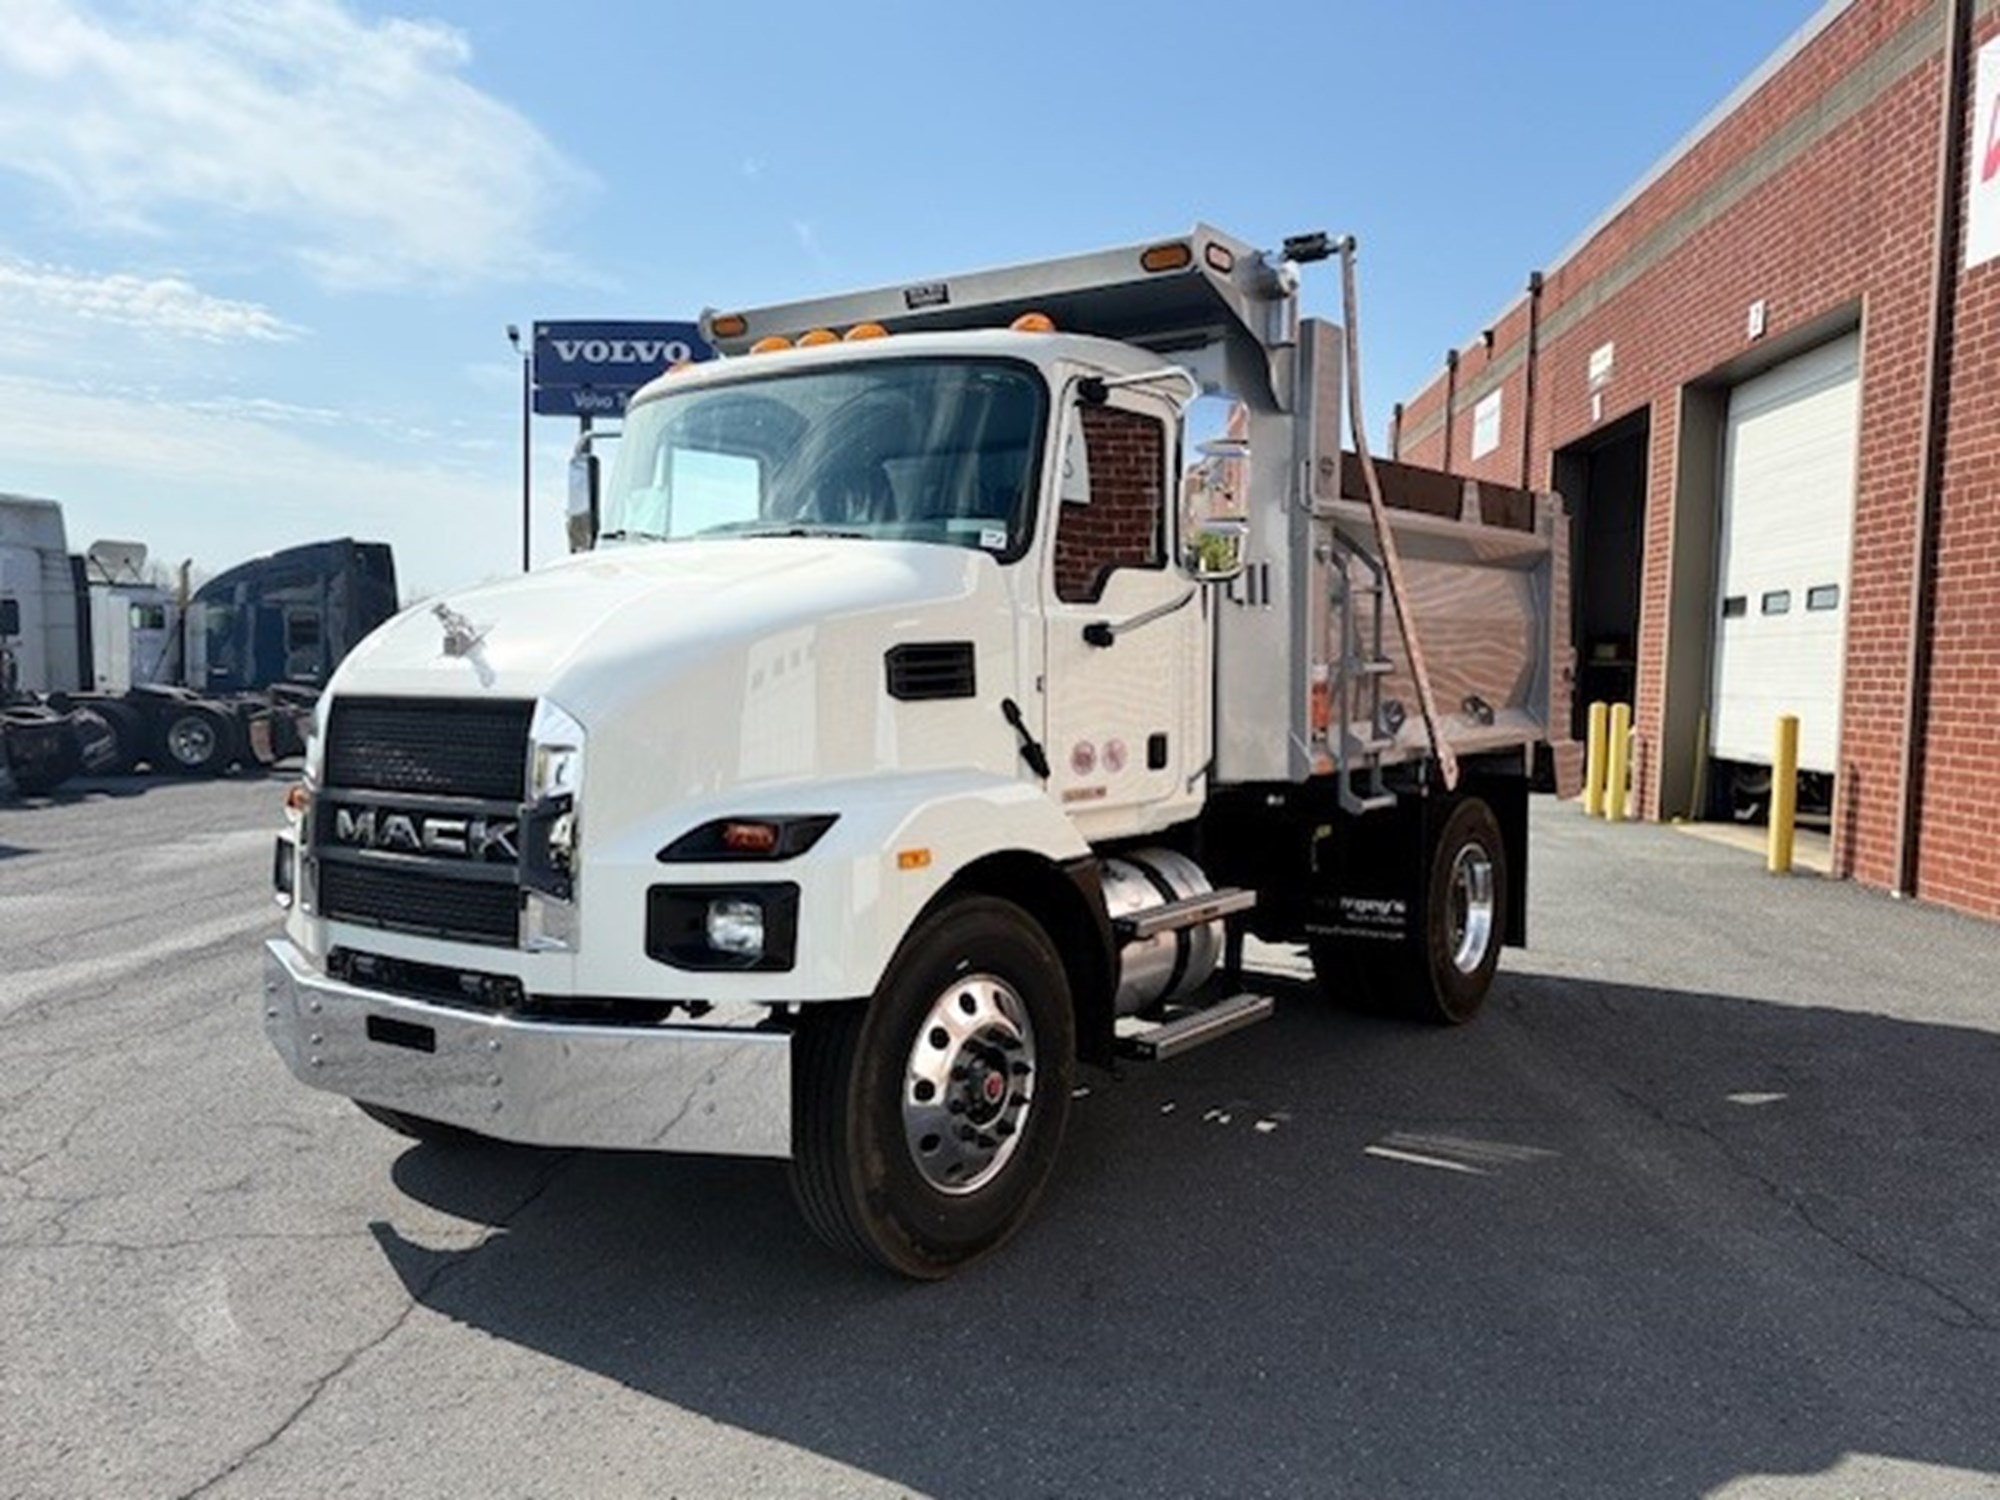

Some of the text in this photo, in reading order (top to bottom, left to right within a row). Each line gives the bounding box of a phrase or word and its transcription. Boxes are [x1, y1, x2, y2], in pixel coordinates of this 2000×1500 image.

[552, 340, 691, 363] VOLVO
[572, 391, 613, 409] Volvo
[336, 808, 518, 856] MACK
